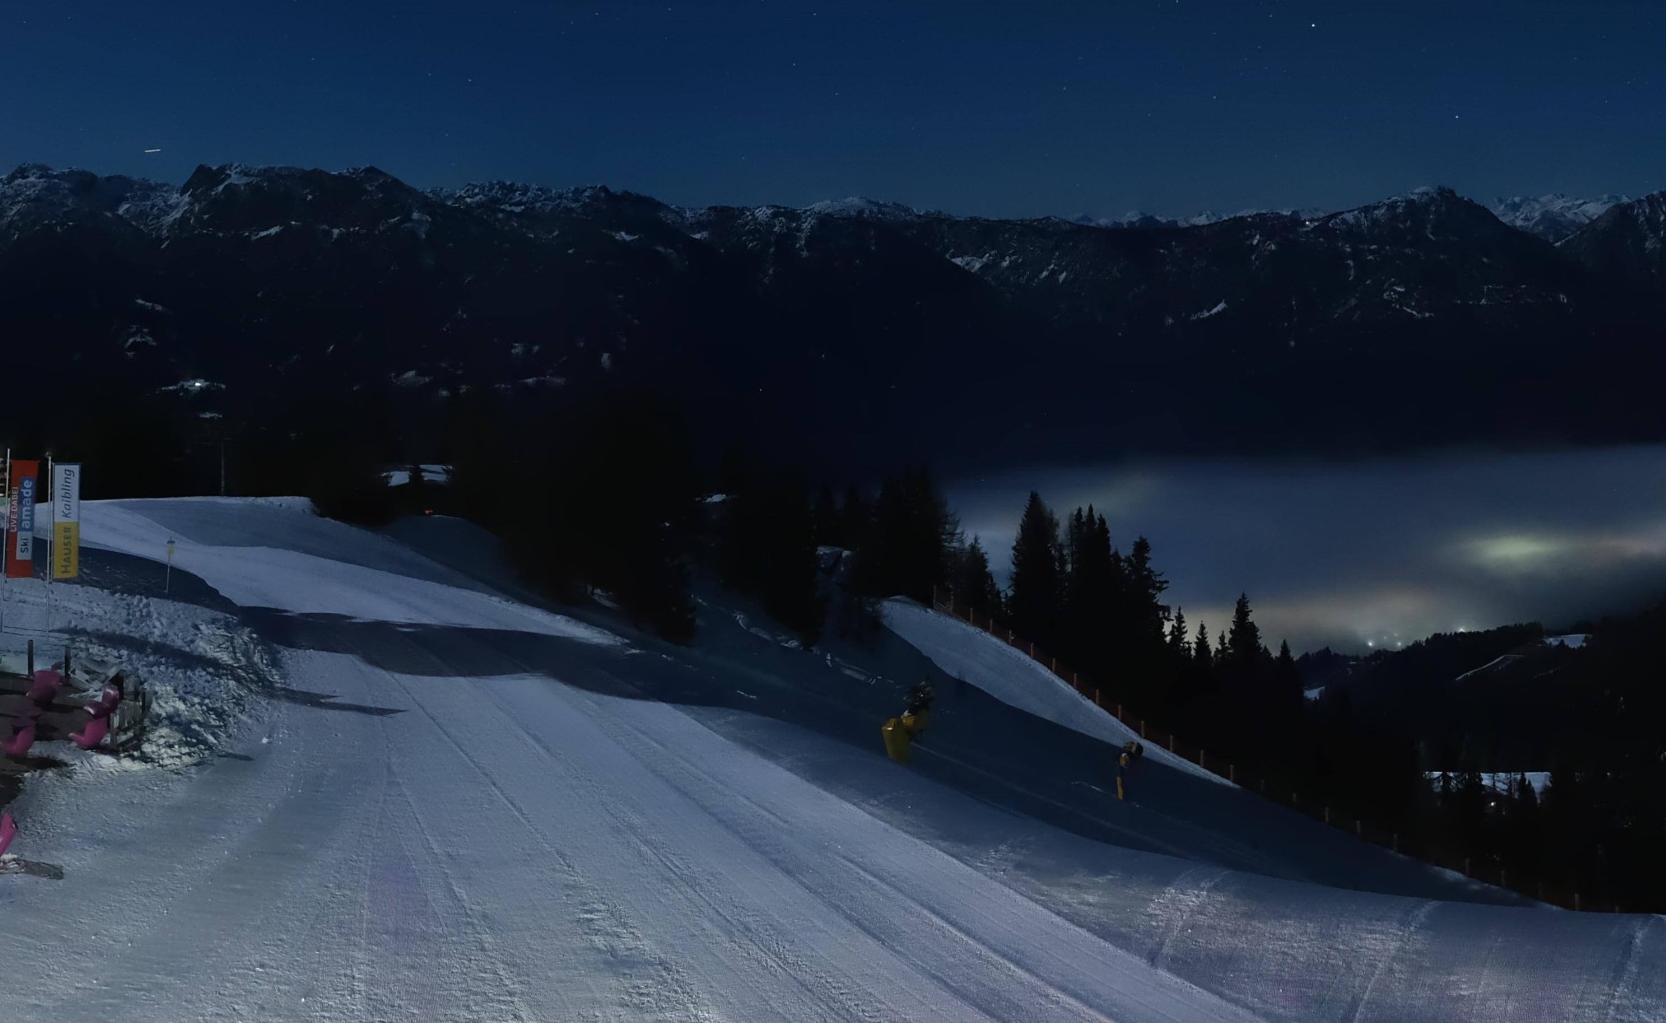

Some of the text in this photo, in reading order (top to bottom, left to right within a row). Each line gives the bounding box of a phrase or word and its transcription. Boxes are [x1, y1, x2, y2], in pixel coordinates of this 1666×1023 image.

[10, 486, 19, 532] LIVE DABEI
[61, 468, 74, 574] HAUSER Kaibling
